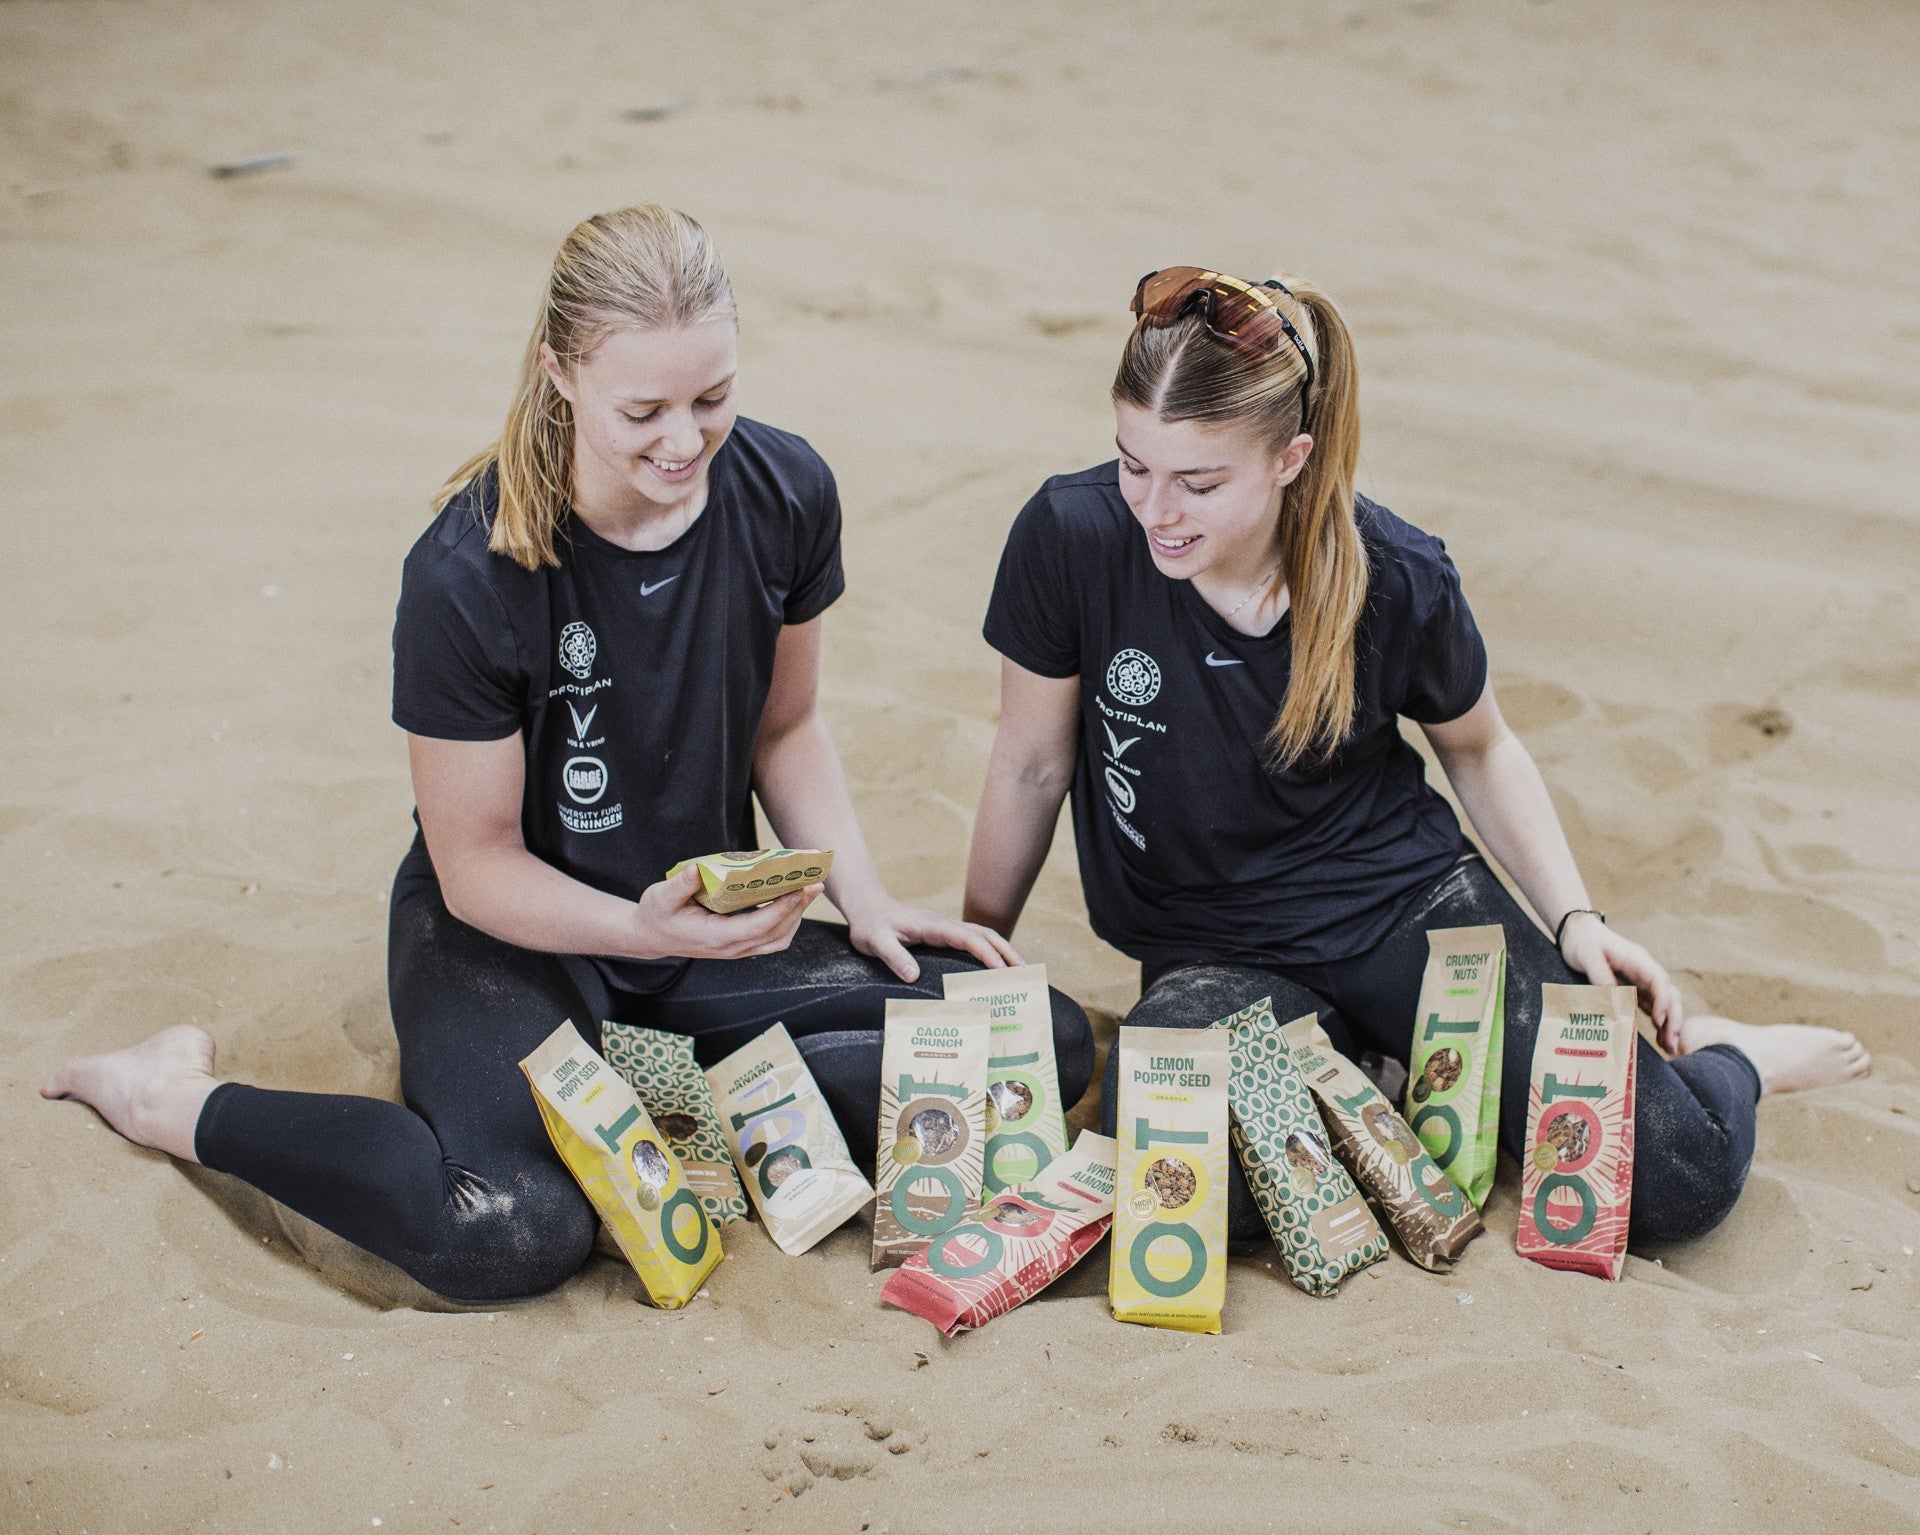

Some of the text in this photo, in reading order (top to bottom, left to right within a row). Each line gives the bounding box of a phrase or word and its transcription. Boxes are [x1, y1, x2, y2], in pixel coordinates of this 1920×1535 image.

[549, 678, 612, 698] PROTIPAN
[556, 801, 621, 820] NIVERSITY FUND
[559, 810, 622, 829] AGENINGEN
[1445, 953, 1490, 967] CRUNCHY
[1453, 968, 1478, 981] NUTS
[969, 993, 1028, 1006] UNCHY
[990, 1006, 1017, 1018] UTS
[1569, 1013, 1605, 1026] WHITE
[916, 1027, 959, 1037] CACAO
[1560, 1027, 1609, 1042] ALMOND
[911, 1036, 963, 1048] CRUNCH
[552, 1057, 580, 1083] LEMON
[1150, 1057, 1194, 1071] LEMON
[557, 1061, 600, 1101] POPPY SEED
[1134, 1070, 1211, 1088] POPPY SEED
[1086, 1162, 1116, 1181] WHITE
[1071, 1171, 1115, 1195] ALMOND
[1134, 1199, 1152, 1208] HIGH
